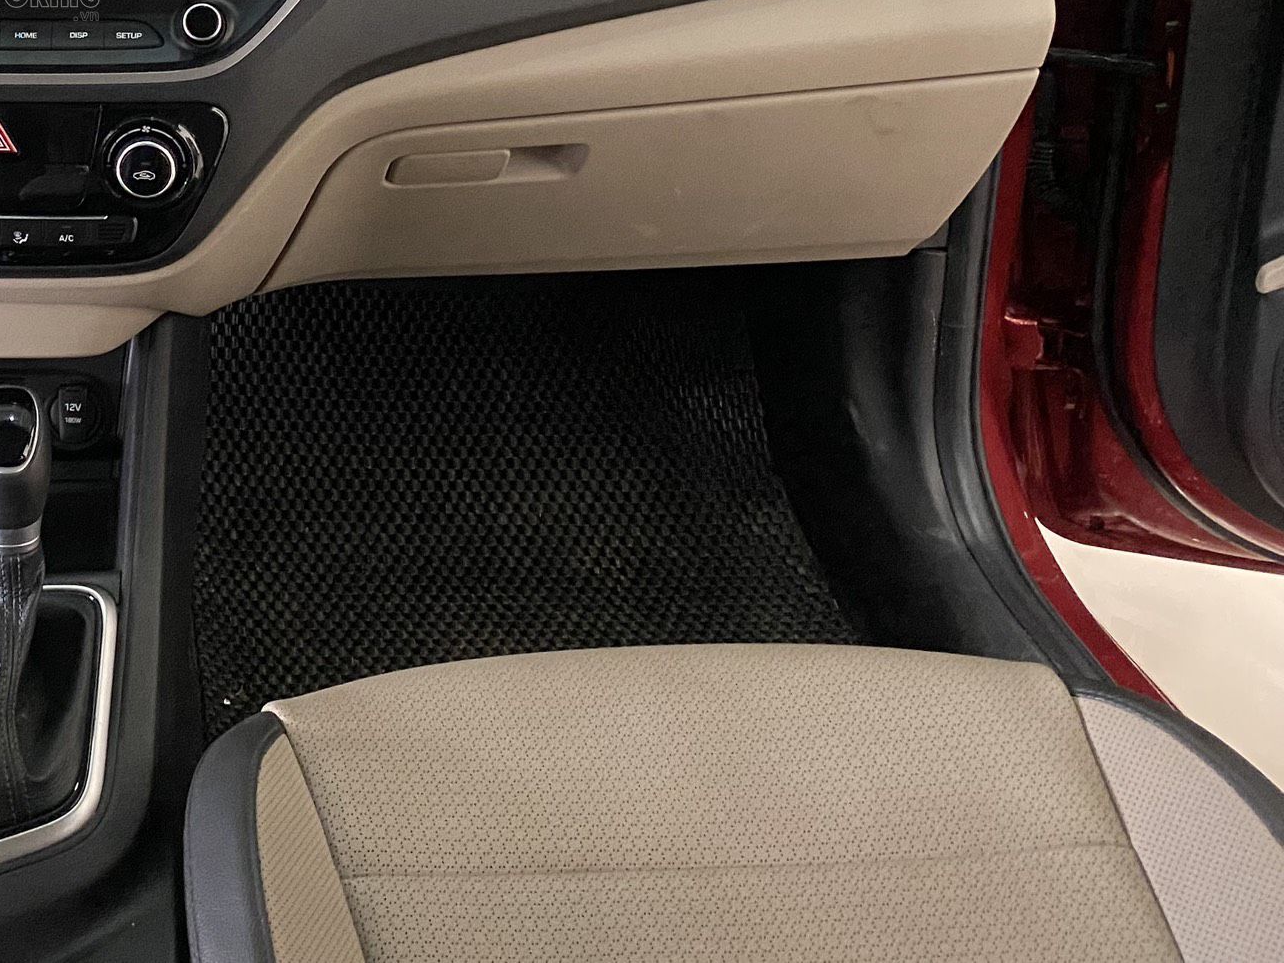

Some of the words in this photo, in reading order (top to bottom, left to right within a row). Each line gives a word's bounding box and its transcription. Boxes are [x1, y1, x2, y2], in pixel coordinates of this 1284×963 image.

[14, 31, 38, 39] HOME
[69, 31, 89, 39] DISP
[115, 31, 143, 39] SETUP
[58, 234, 74, 243] A/C
[64, 402, 82, 412] 12V
